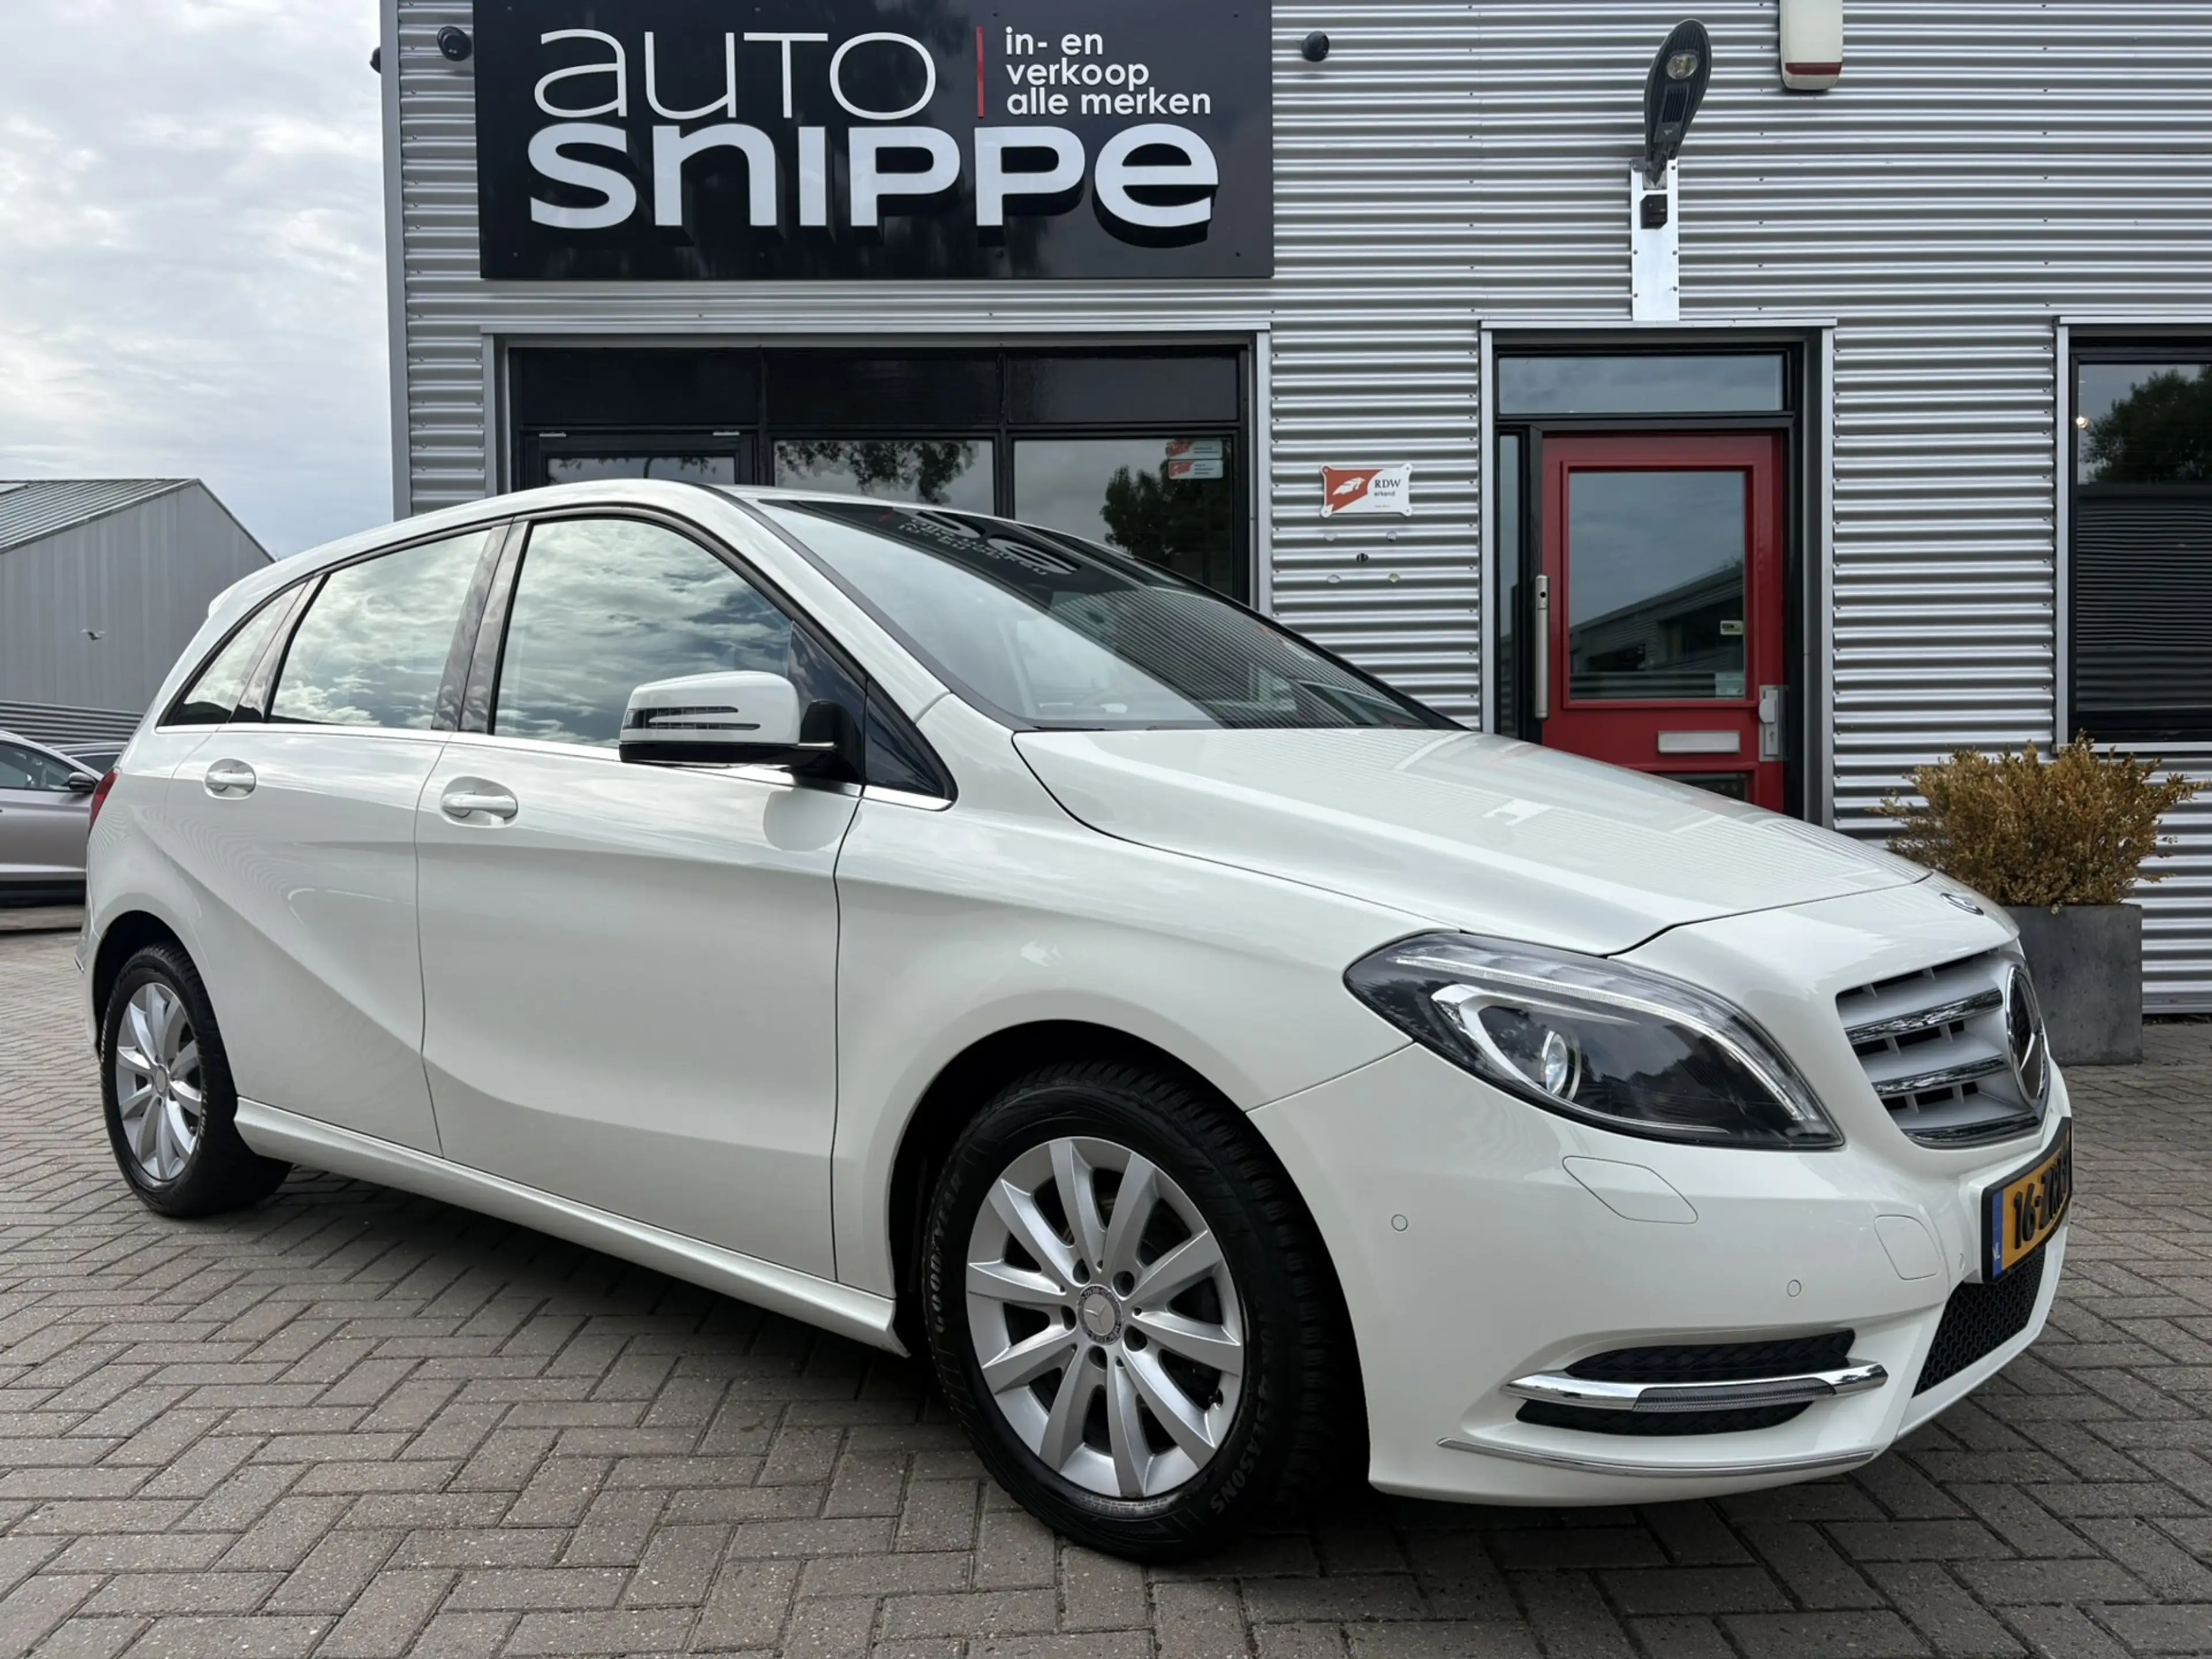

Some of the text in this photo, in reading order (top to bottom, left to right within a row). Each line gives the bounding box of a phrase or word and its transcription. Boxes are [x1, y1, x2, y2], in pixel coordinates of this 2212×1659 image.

[1005, 25, 1104, 56] in- en
[1005, 57, 1150, 92] verkoop
[1006, 86, 1211, 115] alle merken
[1374, 479, 1401, 488] RDW
